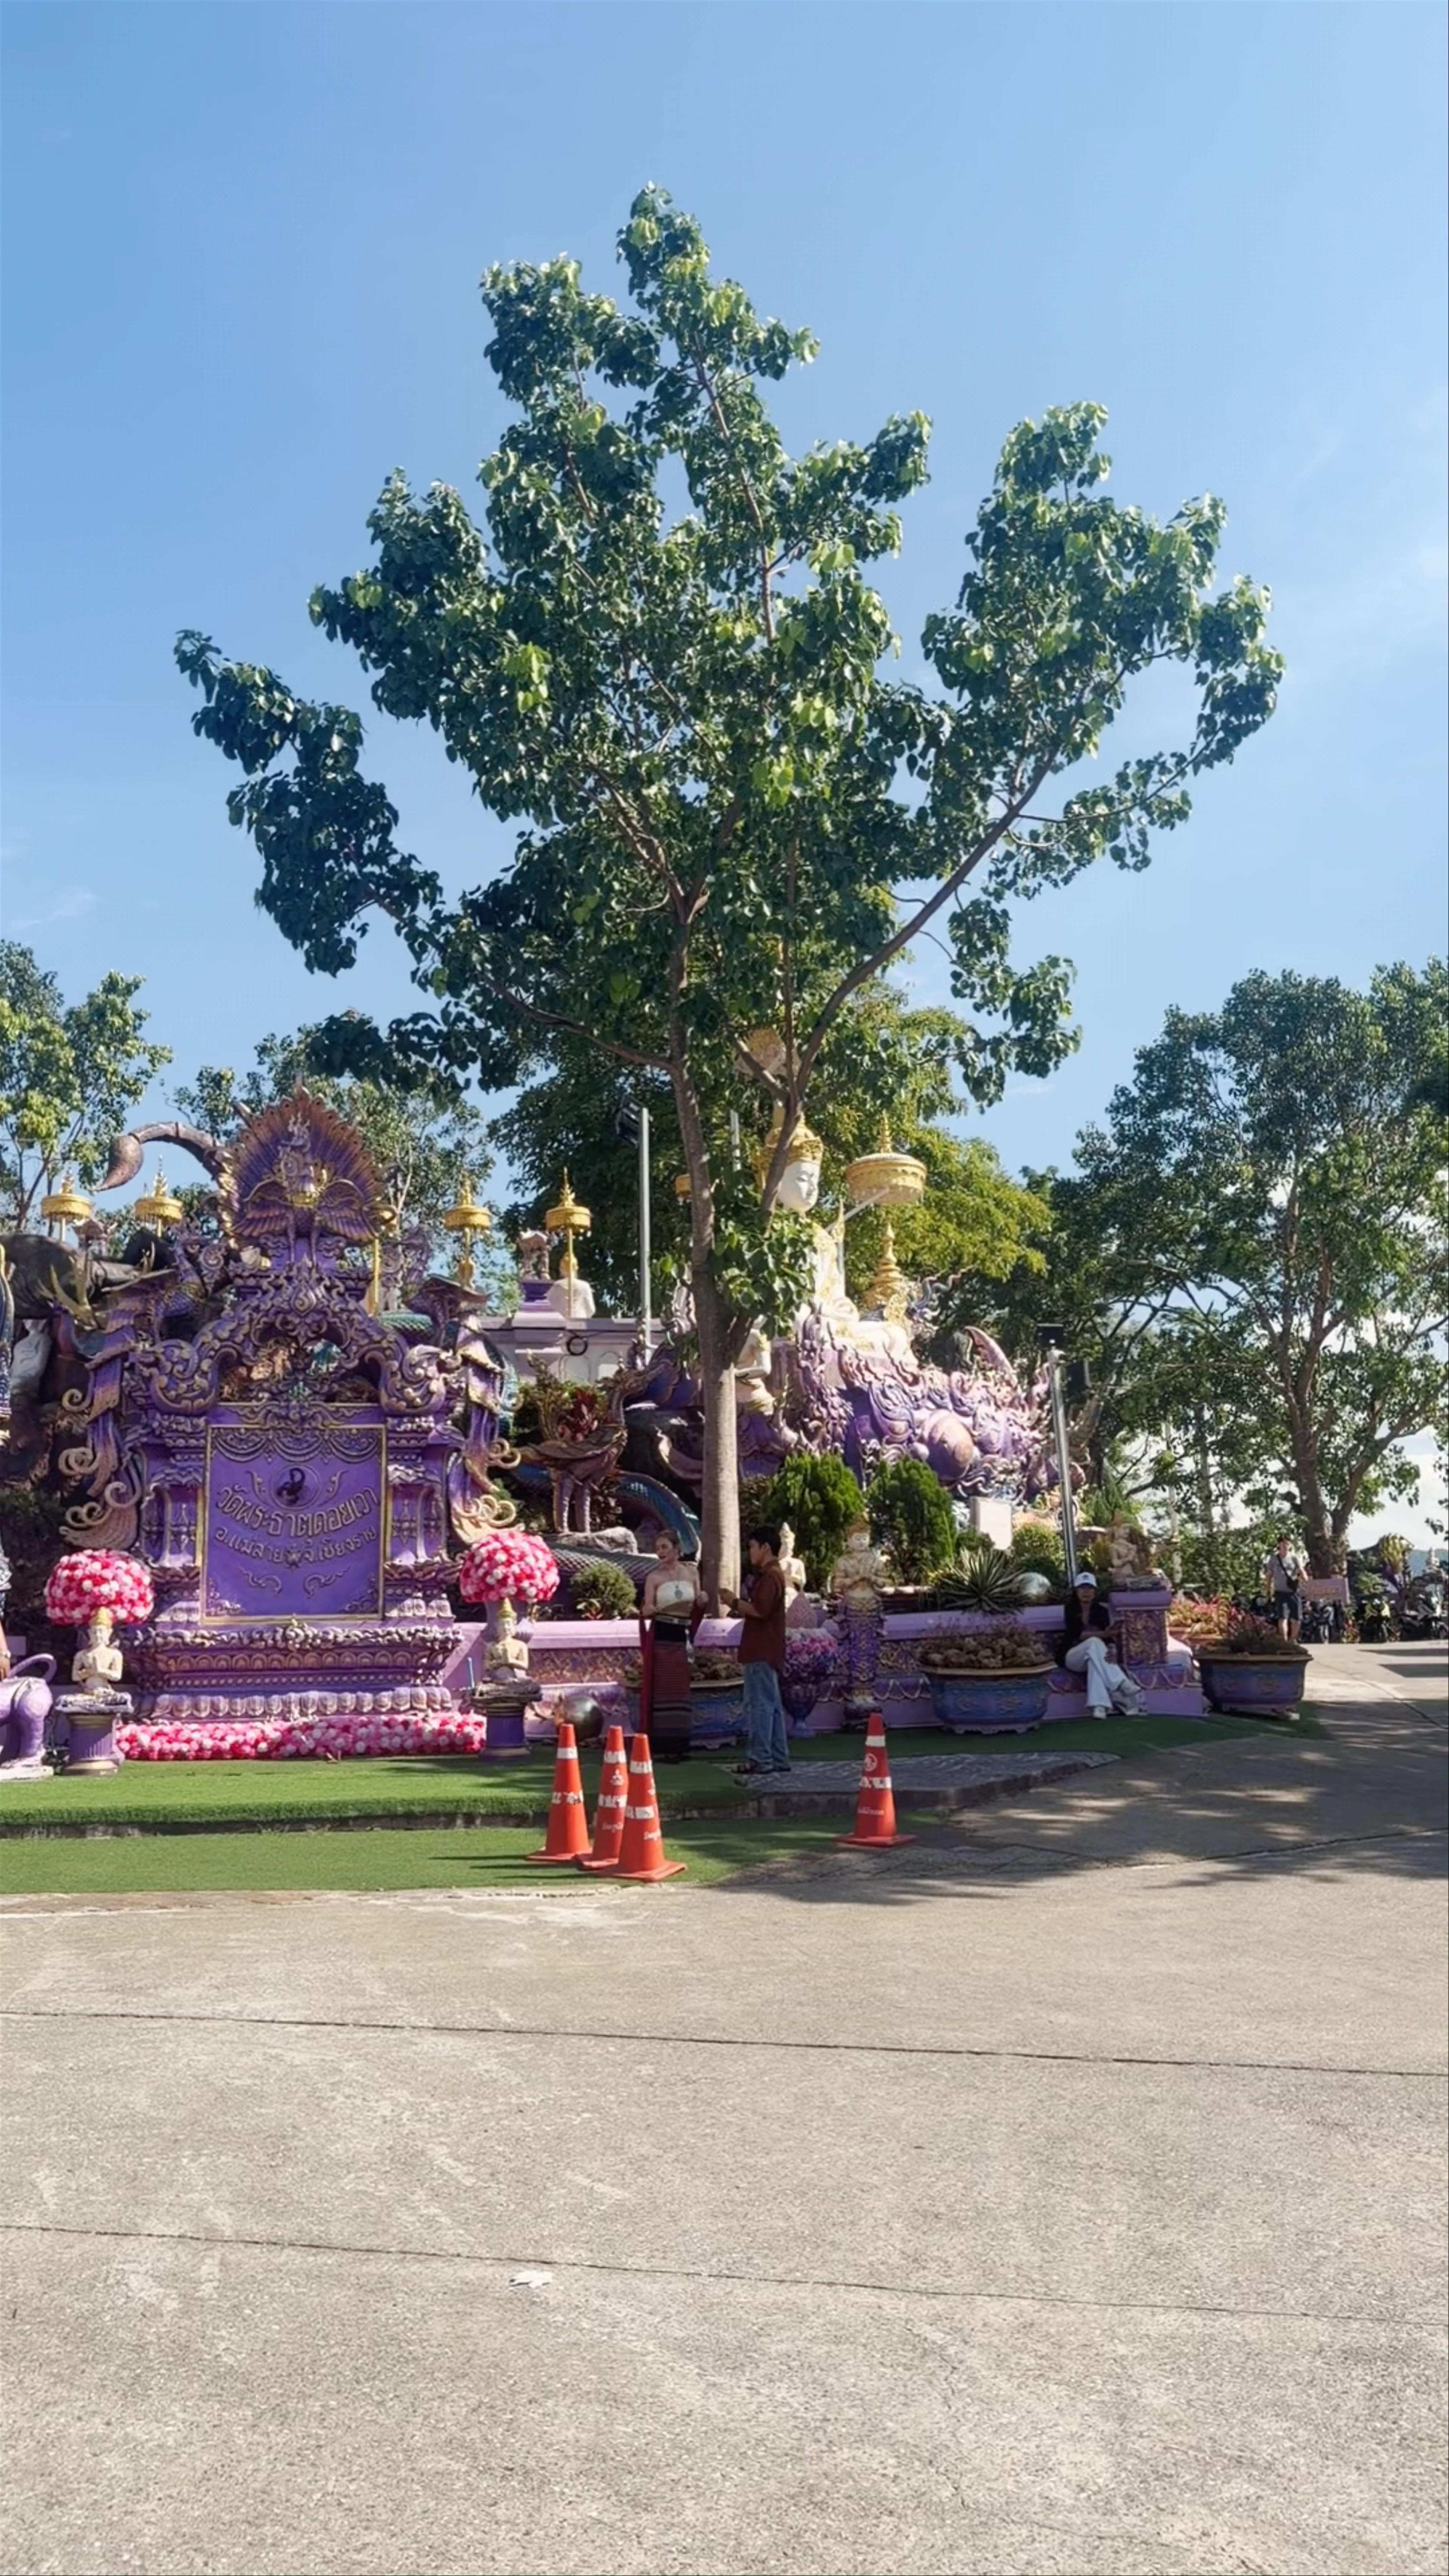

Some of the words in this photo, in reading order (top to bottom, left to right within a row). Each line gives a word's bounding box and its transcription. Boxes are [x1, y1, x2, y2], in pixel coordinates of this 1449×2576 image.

[216, 1484, 380, 1546] วัดพระธาตุดอยเวา
